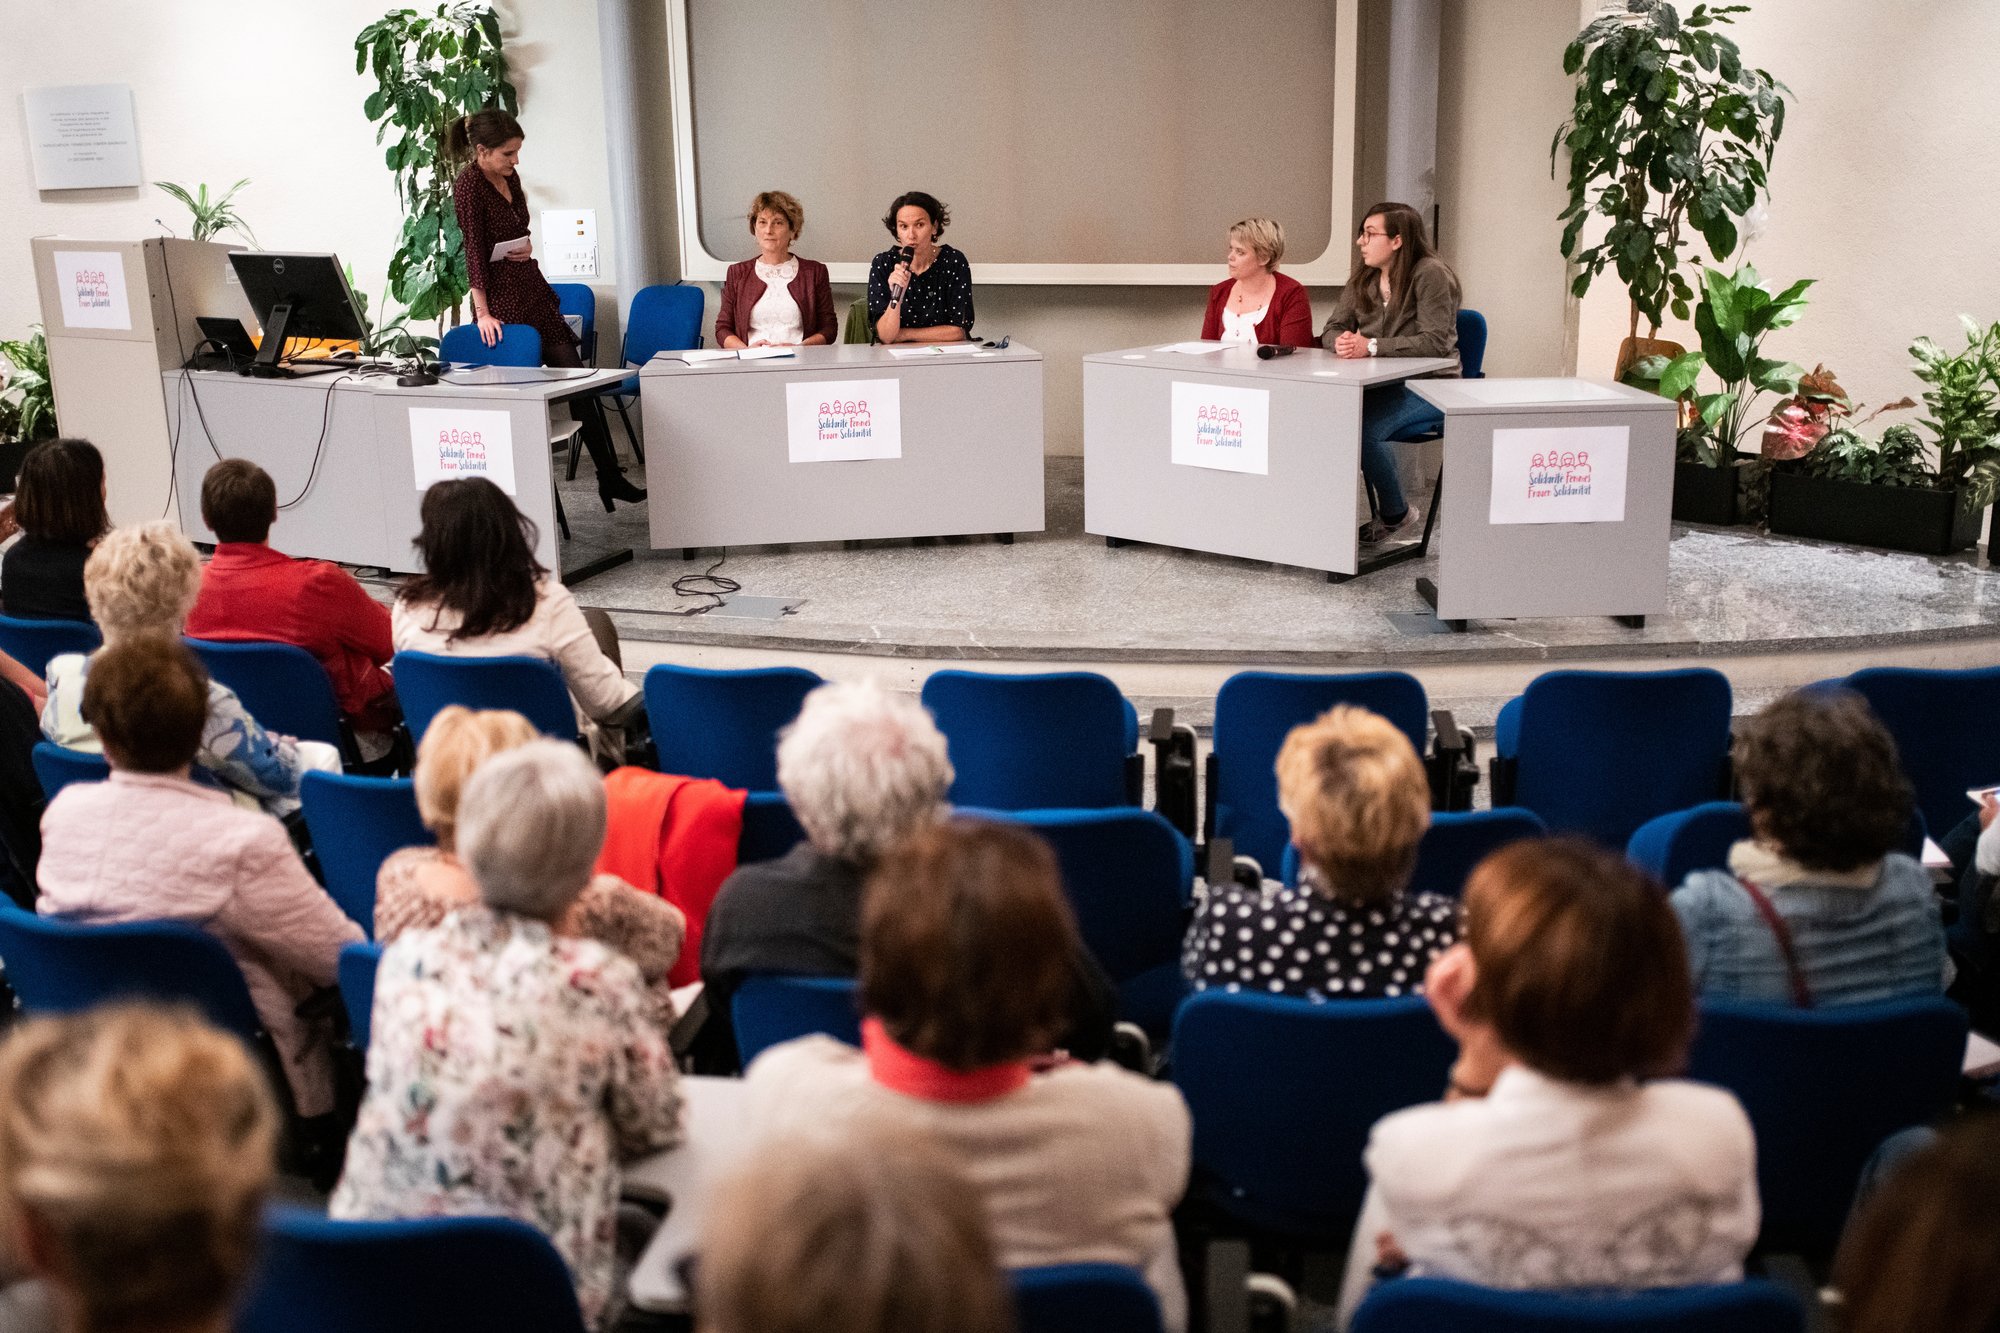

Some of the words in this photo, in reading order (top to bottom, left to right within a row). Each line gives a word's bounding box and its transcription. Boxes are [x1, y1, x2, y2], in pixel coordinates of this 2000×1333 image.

[849, 416, 871, 428] Femmes
[818, 429, 838, 441] Frauen
[466, 448, 486, 459] Femmes
[1566, 470, 1591, 484] Femmes
[1528, 486, 1551, 498] Frauen
